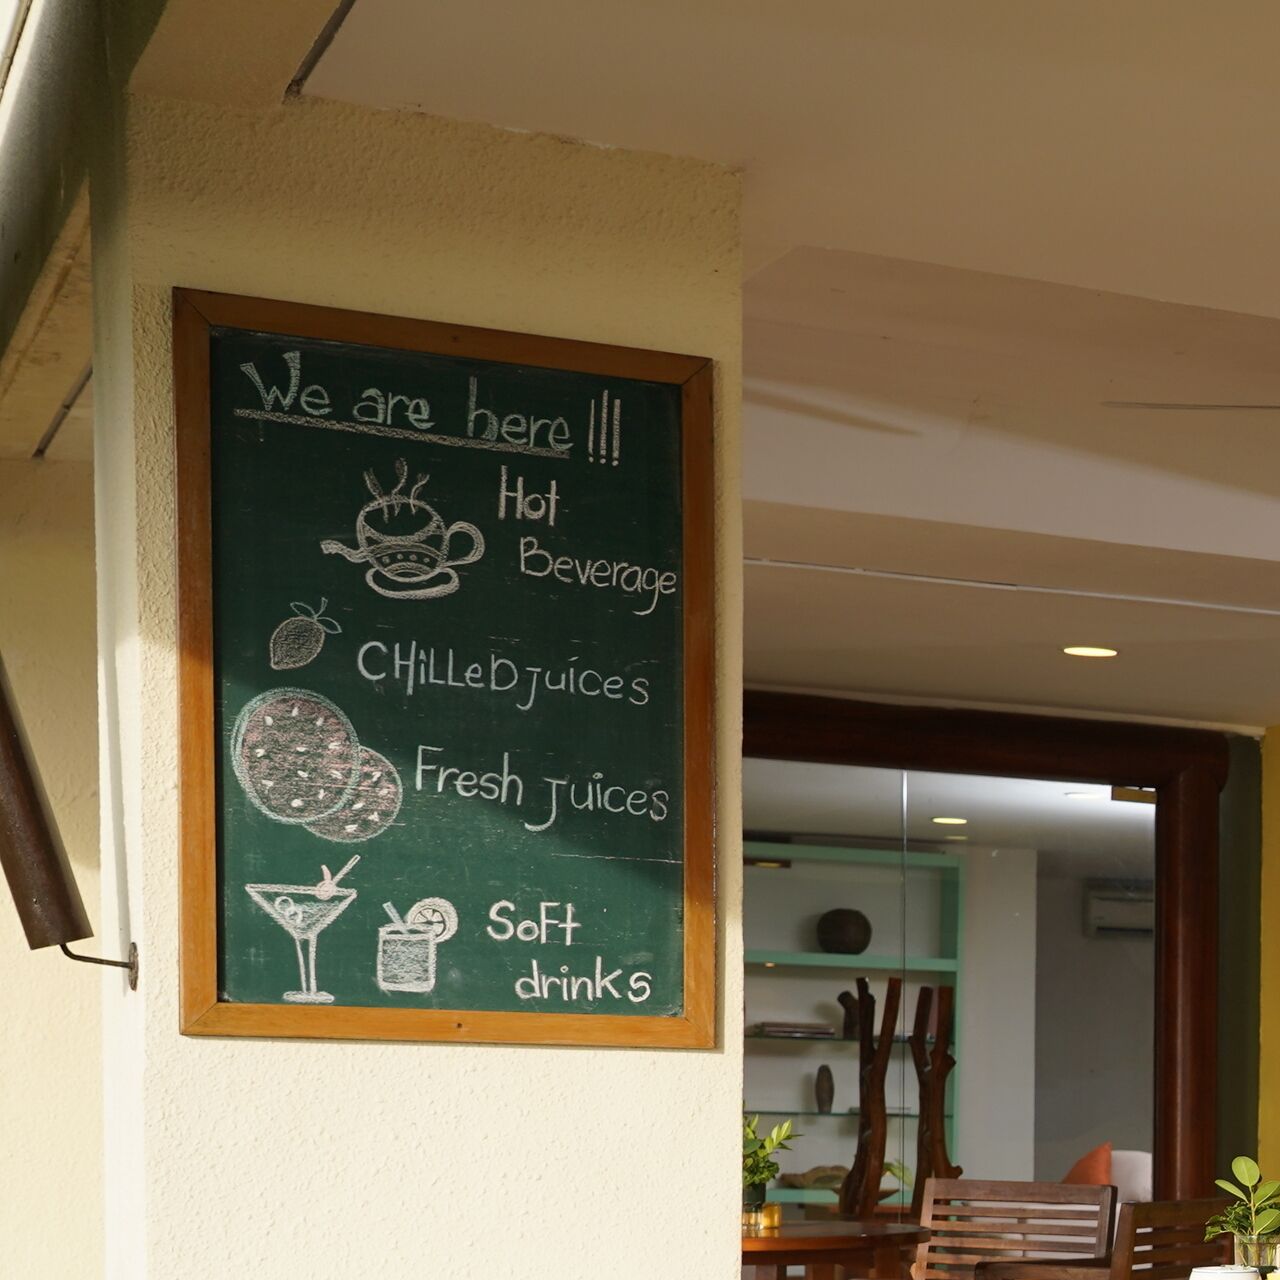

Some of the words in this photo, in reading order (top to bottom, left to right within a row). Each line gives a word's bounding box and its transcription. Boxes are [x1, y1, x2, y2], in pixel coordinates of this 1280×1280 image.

[240, 350, 331, 416] We
[352, 387, 435, 430] are
[467, 376, 575, 452] here
[587, 389, 622, 467] !!!
[498, 465, 561, 527] Hot
[520, 536, 678, 616] Beverage
[415, 745, 524, 805] Fresh
[515, 956, 652, 1002] drinks
